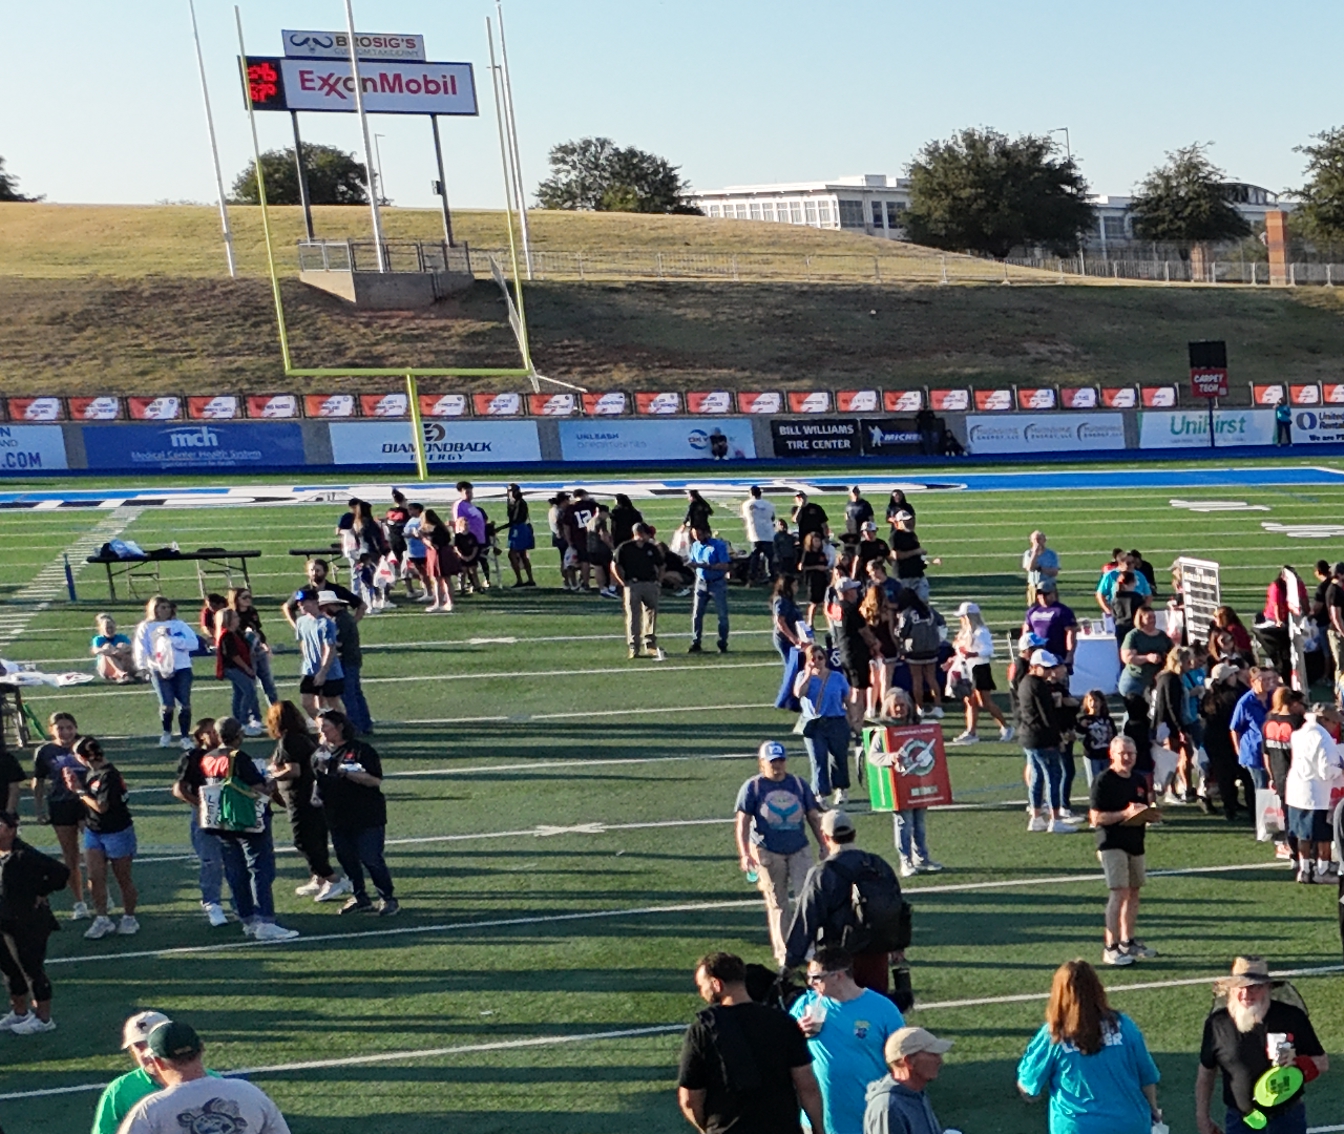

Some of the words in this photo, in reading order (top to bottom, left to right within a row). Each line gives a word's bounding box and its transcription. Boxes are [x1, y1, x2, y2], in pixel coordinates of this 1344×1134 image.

[1193, 373, 1224, 384] CARPET
[169, 425, 219, 448] mch
[778, 424, 802, 437] BILL
[803, 423, 855, 436] WILLIAMS
[576, 433, 620, 441] UNLEASH
[785, 439, 810, 451] TIRE
[811, 438, 852, 450] CENTER
[409, 453, 465, 462] EERGY
[574, 509, 593, 529] 12
